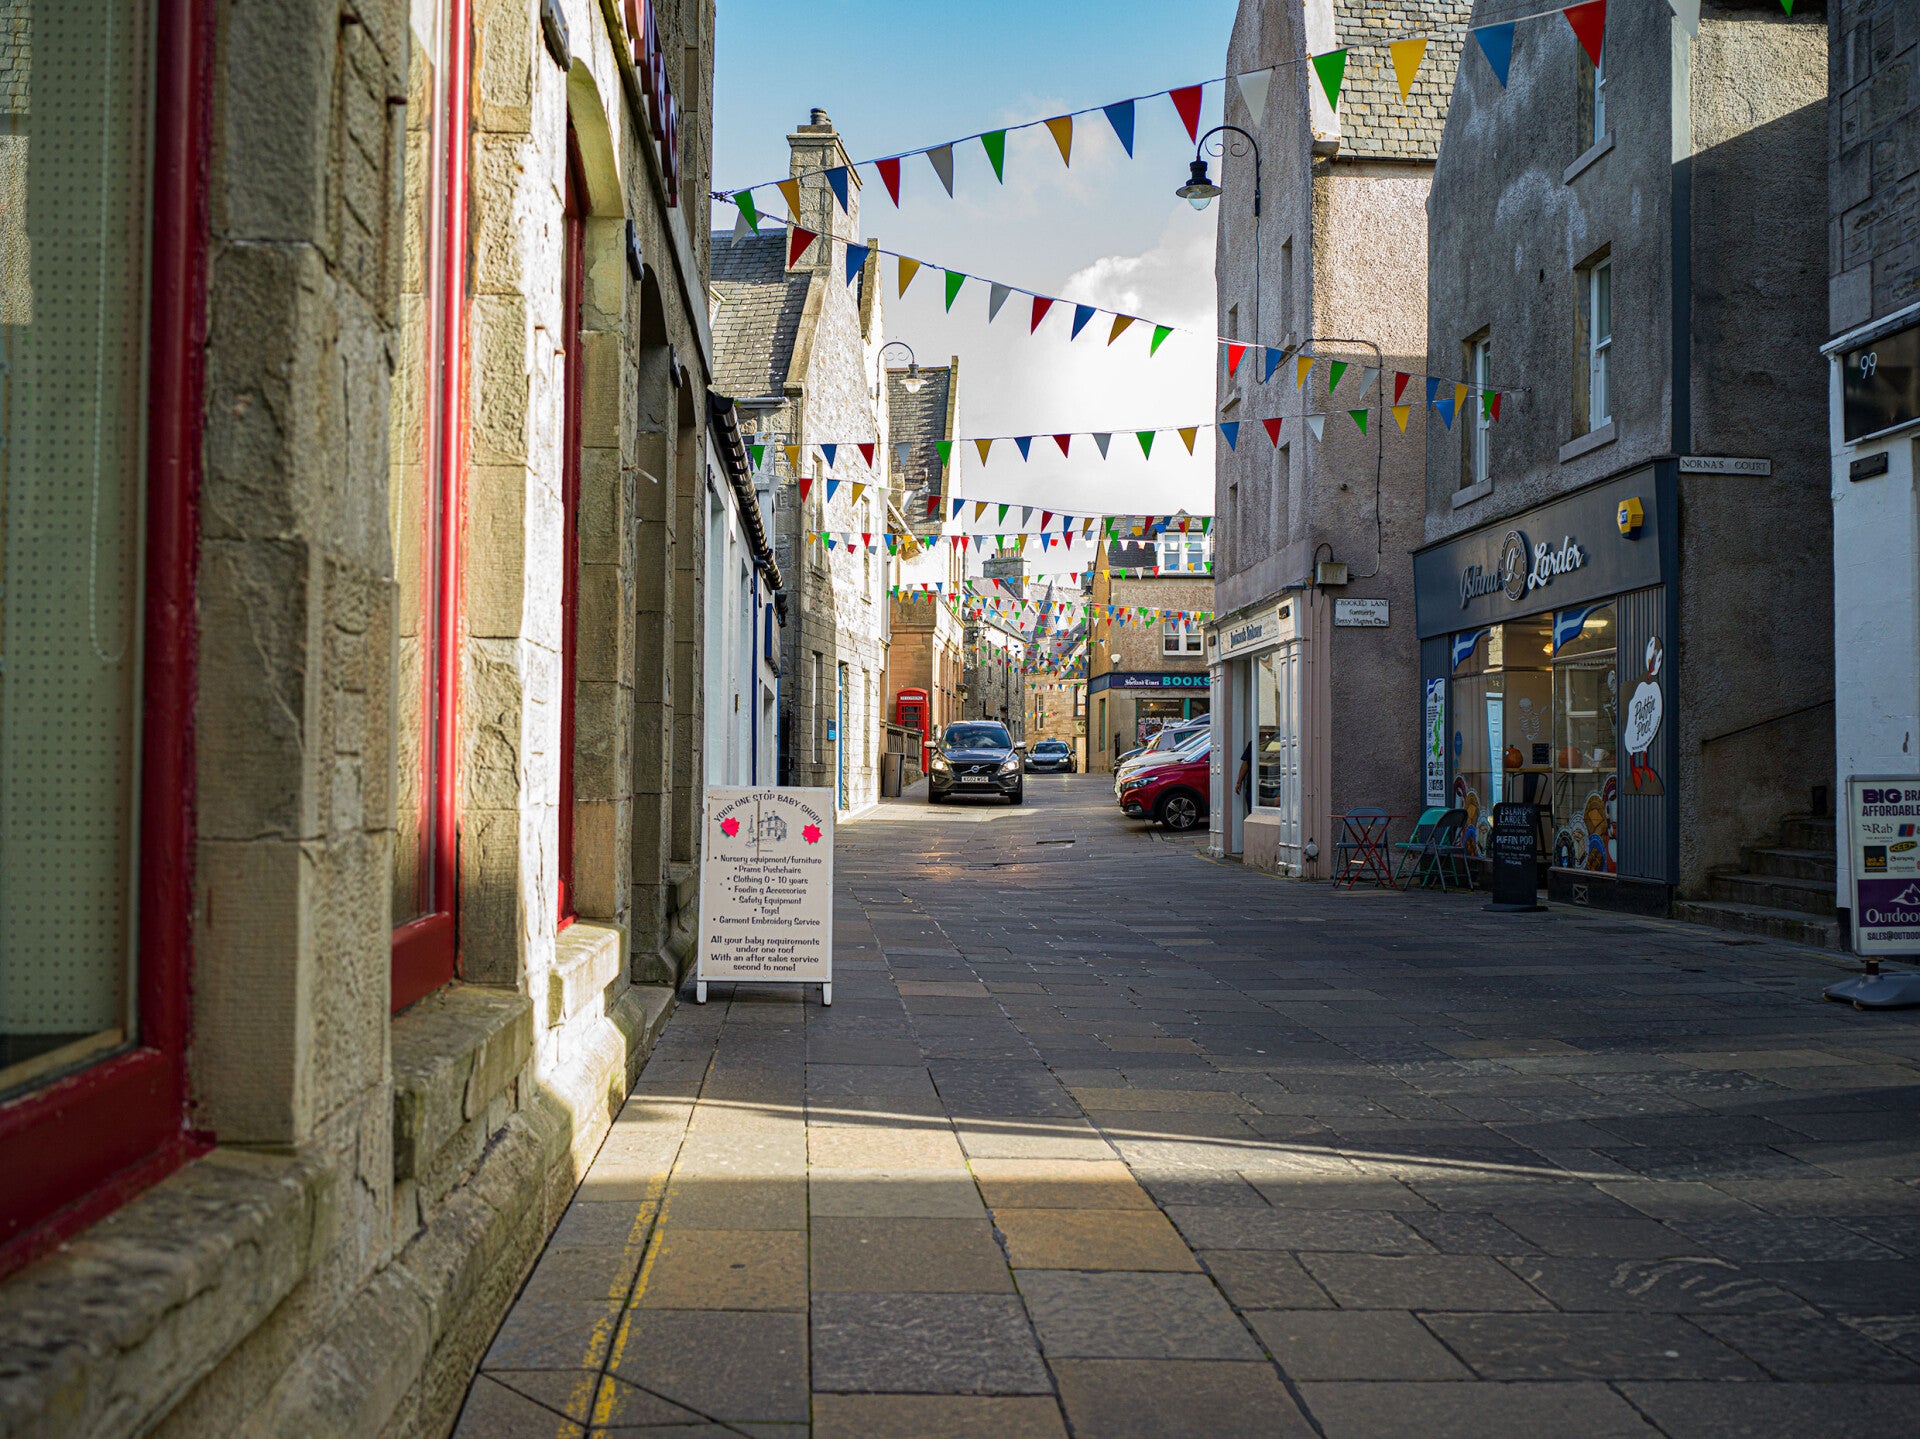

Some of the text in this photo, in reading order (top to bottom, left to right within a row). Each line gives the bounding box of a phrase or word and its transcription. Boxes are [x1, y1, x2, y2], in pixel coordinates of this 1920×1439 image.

[1860, 351, 1878, 380] 99
[1681, 459, 1767, 471] NORNA'S COURT
[1527, 535, 1585, 590] Larder
[1349, 609, 1376, 618] formerly
[1162, 676, 1210, 686] BOOKS
[1862, 788, 1902, 804] BIG
[713, 793, 823, 825] YOUR ONE STOP BABY SHOP!
[1862, 805, 1920, 817] AFFORDABLE
[1499, 814, 1527, 825] LARDER
[1871, 823, 1893, 834] Rab
[720, 854, 748, 864] Nursery
[738, 865, 802, 874] Prams Pushchairs
[733, 875, 763, 885] Clothing
[764, 876, 770, 884] 0
[778, 876, 788, 884] 10
[788, 878, 809, 886] years
[765, 886, 807, 895] Accessories
[738, 895, 802, 906] Safety Equipment
[760, 906, 780, 916] Toys!
[1866, 907, 1920, 924] Outdoo
[719, 915, 821, 926] Garment Embroidery Service
[710, 935, 820, 947] All your baby requirements
[735, 945, 795, 954] under one roof
[710, 953, 732, 962] With
[732, 954, 744, 962] an
[745, 953, 765, 962] after
[767, 955, 789, 963] sales
[732, 963, 796, 972] second to none!
